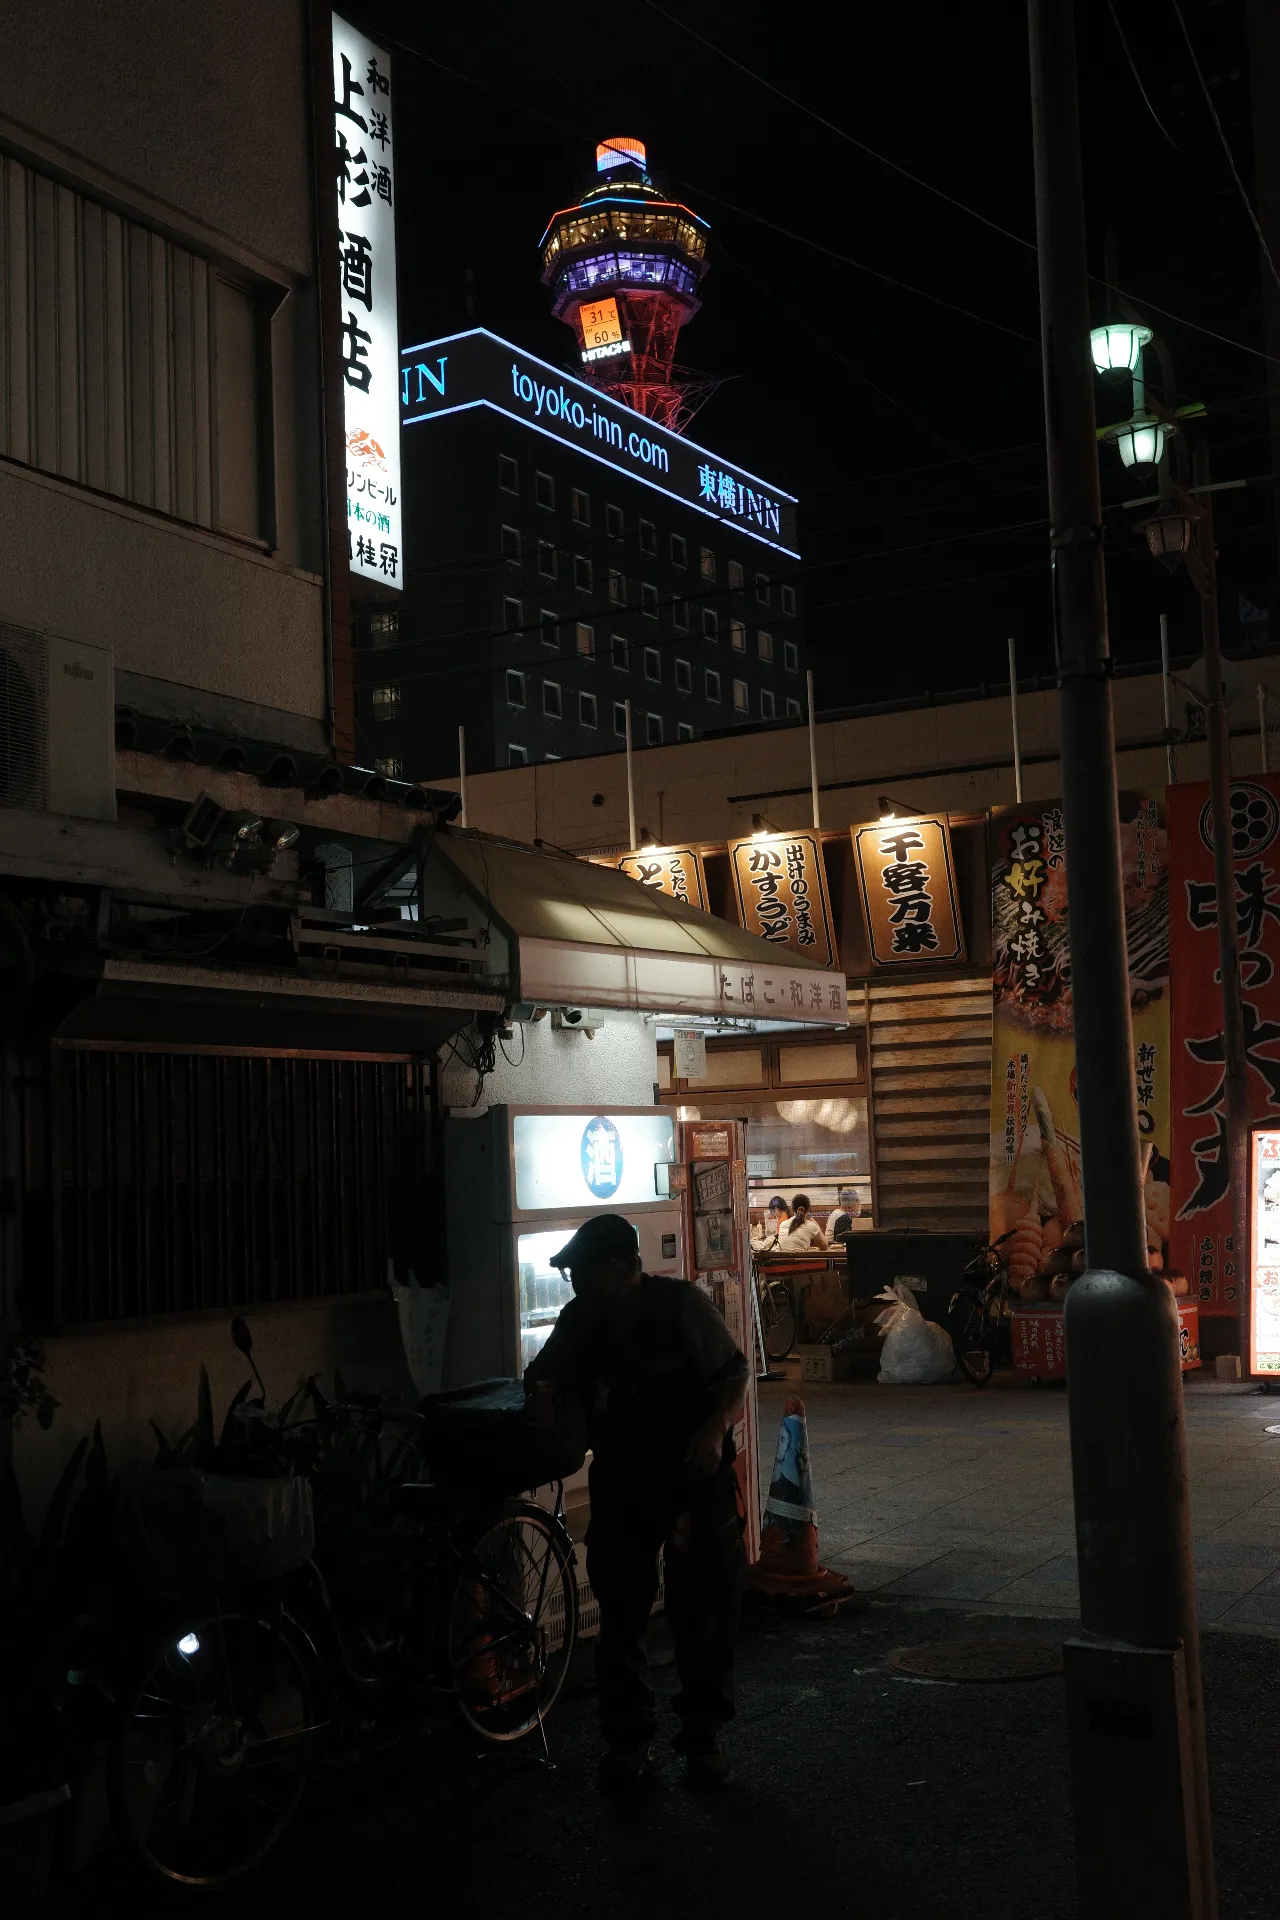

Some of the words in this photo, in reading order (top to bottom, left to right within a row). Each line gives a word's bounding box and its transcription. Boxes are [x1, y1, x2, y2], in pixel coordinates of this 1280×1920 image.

[366, 57, 392, 207] 和洋酒
[334, 52, 373, 394] 上杉酒店
[581, 340, 631, 362] HITACHI
[589, 310, 603, 324] 31
[594, 331, 609, 344] 60
[612, 331, 620, 339] %
[512, 364, 669, 473] toyoko-inn.com
[698, 464, 780, 535] 東横INN
[747, 848, 792, 944] かすうど
[785, 844, 817, 947] 出汁のうまみ
[879, 831, 941, 953] 千客万来
[1004, 825, 1045, 988] お好み焼き
[720, 973, 842, 1011] たばこ・和洋酒
[586, 1125, 618, 1186] 酒
